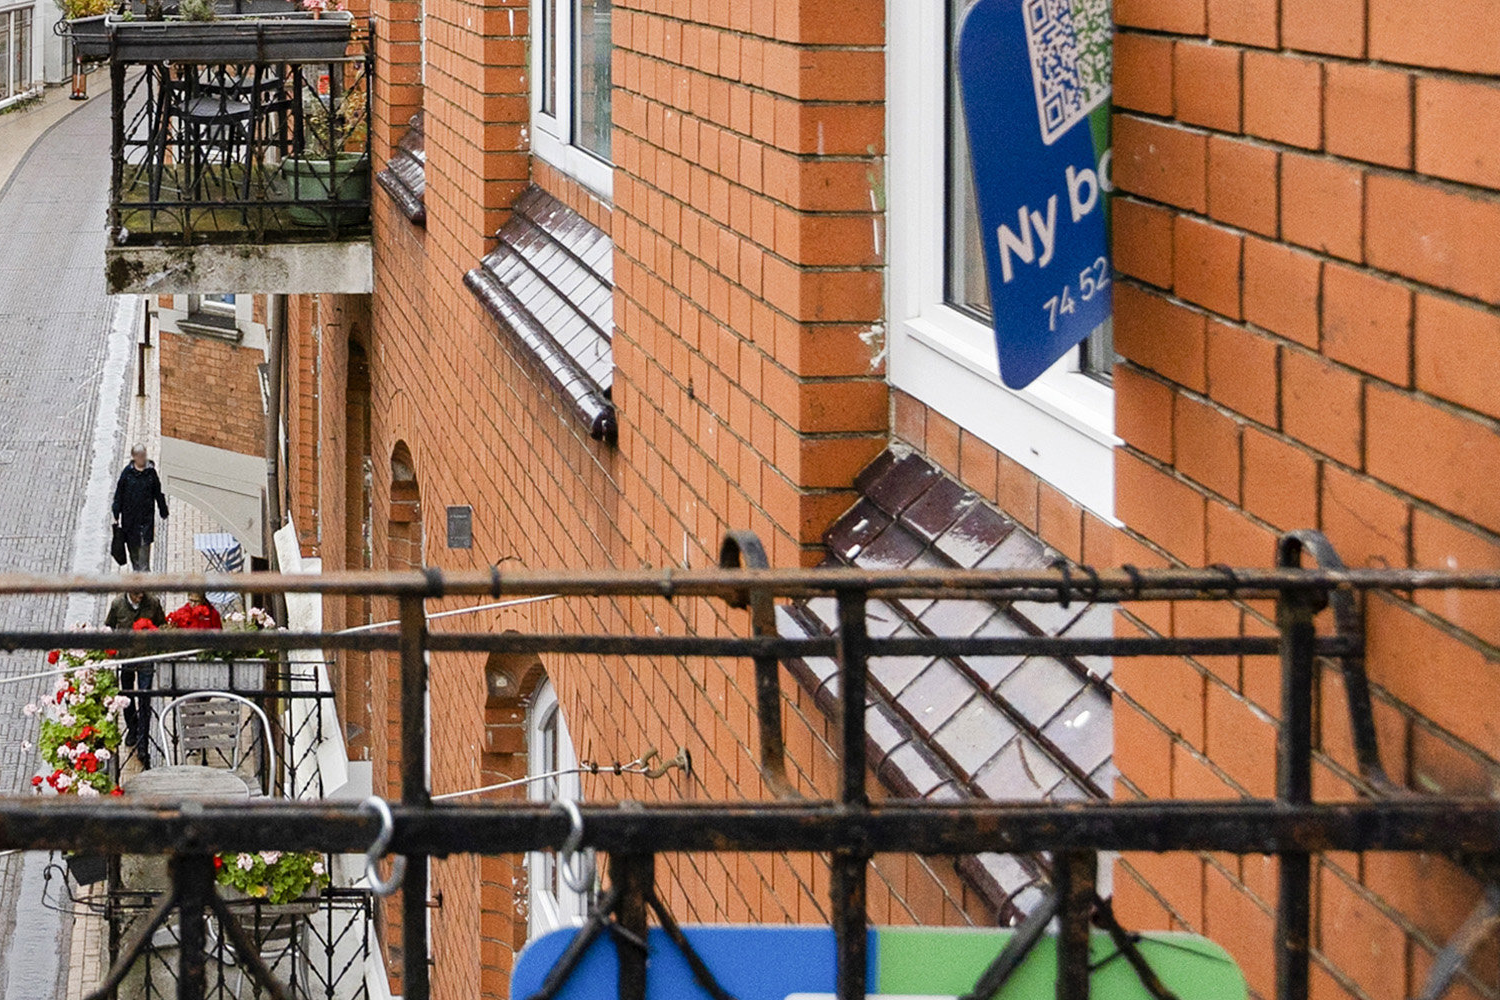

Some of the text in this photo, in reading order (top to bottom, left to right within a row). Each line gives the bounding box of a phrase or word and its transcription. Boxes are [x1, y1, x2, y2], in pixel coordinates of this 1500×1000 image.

[997, 194, 1058, 284] Ny
[1043, 256, 1112, 332] 74 52
